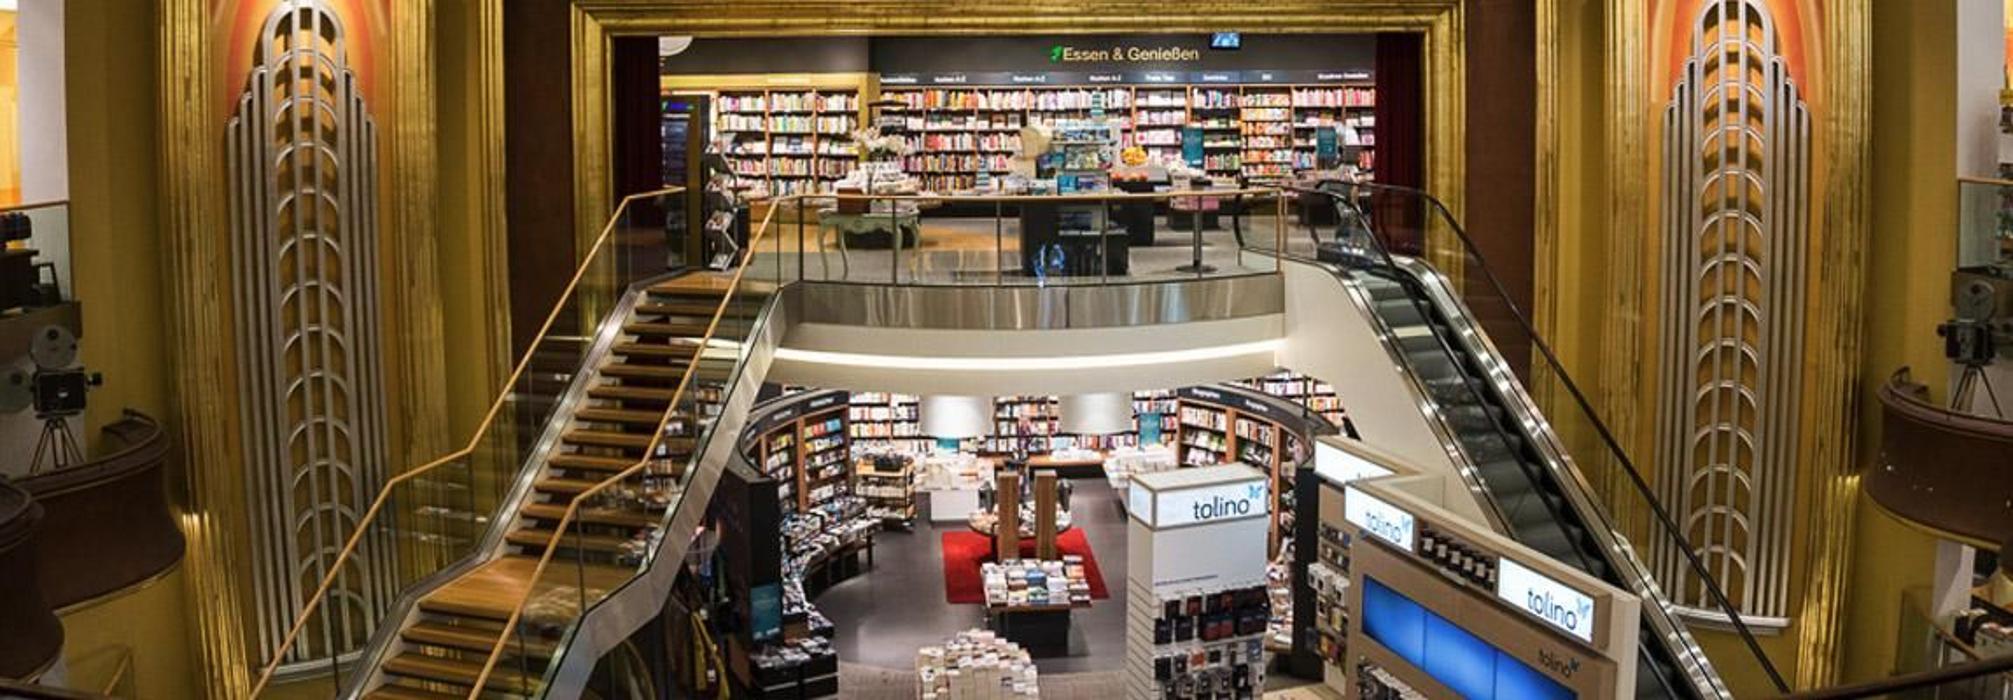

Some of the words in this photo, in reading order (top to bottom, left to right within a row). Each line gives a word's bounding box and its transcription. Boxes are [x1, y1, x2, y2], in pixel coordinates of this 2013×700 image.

[1063, 47, 1109, 60] Essen
[1113, 47, 1123, 60] &
[1127, 47, 1199, 61] Genießen
[1193, 496, 1249, 519] tolino
[1365, 511, 1402, 543] tolino
[1527, 588, 1577, 630] tolino
[1539, 649, 1571, 678] tolino
